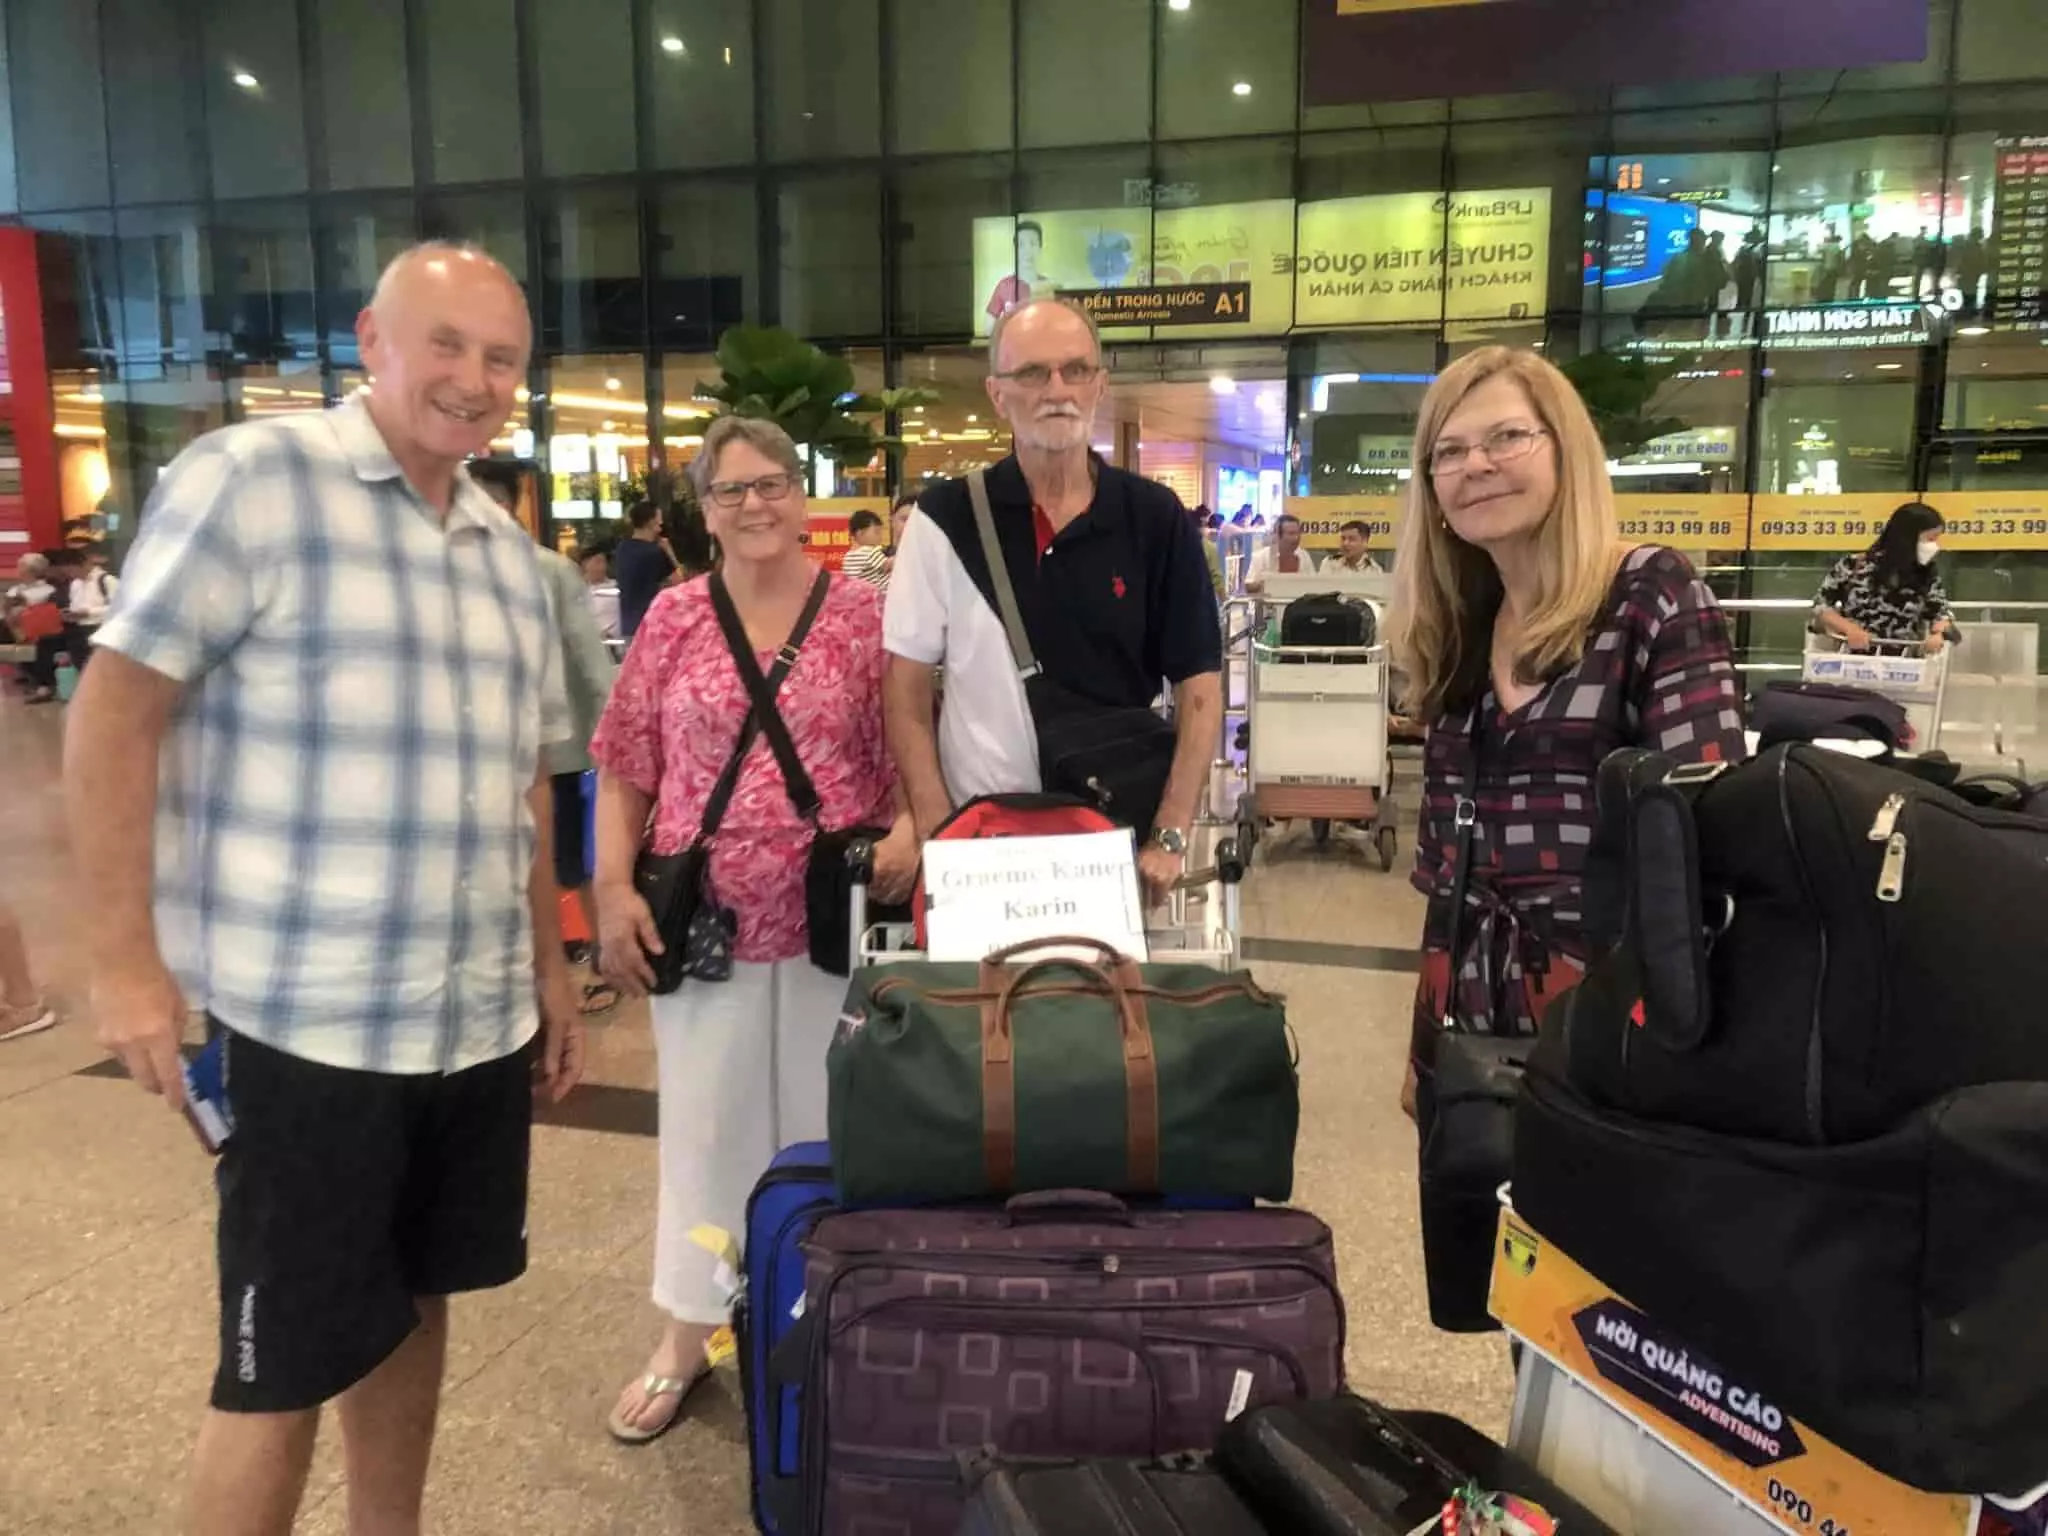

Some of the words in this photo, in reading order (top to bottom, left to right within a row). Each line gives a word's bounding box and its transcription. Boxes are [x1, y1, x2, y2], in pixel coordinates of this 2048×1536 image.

[1115, 294, 1163, 308] TRONG
[1166, 291, 1206, 306] NƯỚC
[1213, 291, 1245, 315] A1
[1094, 312, 1135, 321] Domestic
[1137, 310, 1172, 319] Arrivals
[1653, 520, 1675, 535] 33
[1681, 520, 1703, 535] 99
[1709, 520, 1731, 535] 88
[1761, 520, 1808, 535] 0933
[1813, 520, 1838, 535] 33
[1843, 520, 1867, 535] 99
[1991, 520, 2015, 534] 33
[2022, 520, 2046, 534] 99
[940, 867, 1043, 889] Graeme
[1003, 896, 1079, 921] Karin
[1596, 1315, 1638, 1353] MỜI
[1641, 1339, 1723, 1399] QUẢNG
[1727, 1387, 1783, 1431] CÁO
[1678, 1389, 1782, 1457] ADVERTISING
[1767, 1478, 1812, 1523] 090
